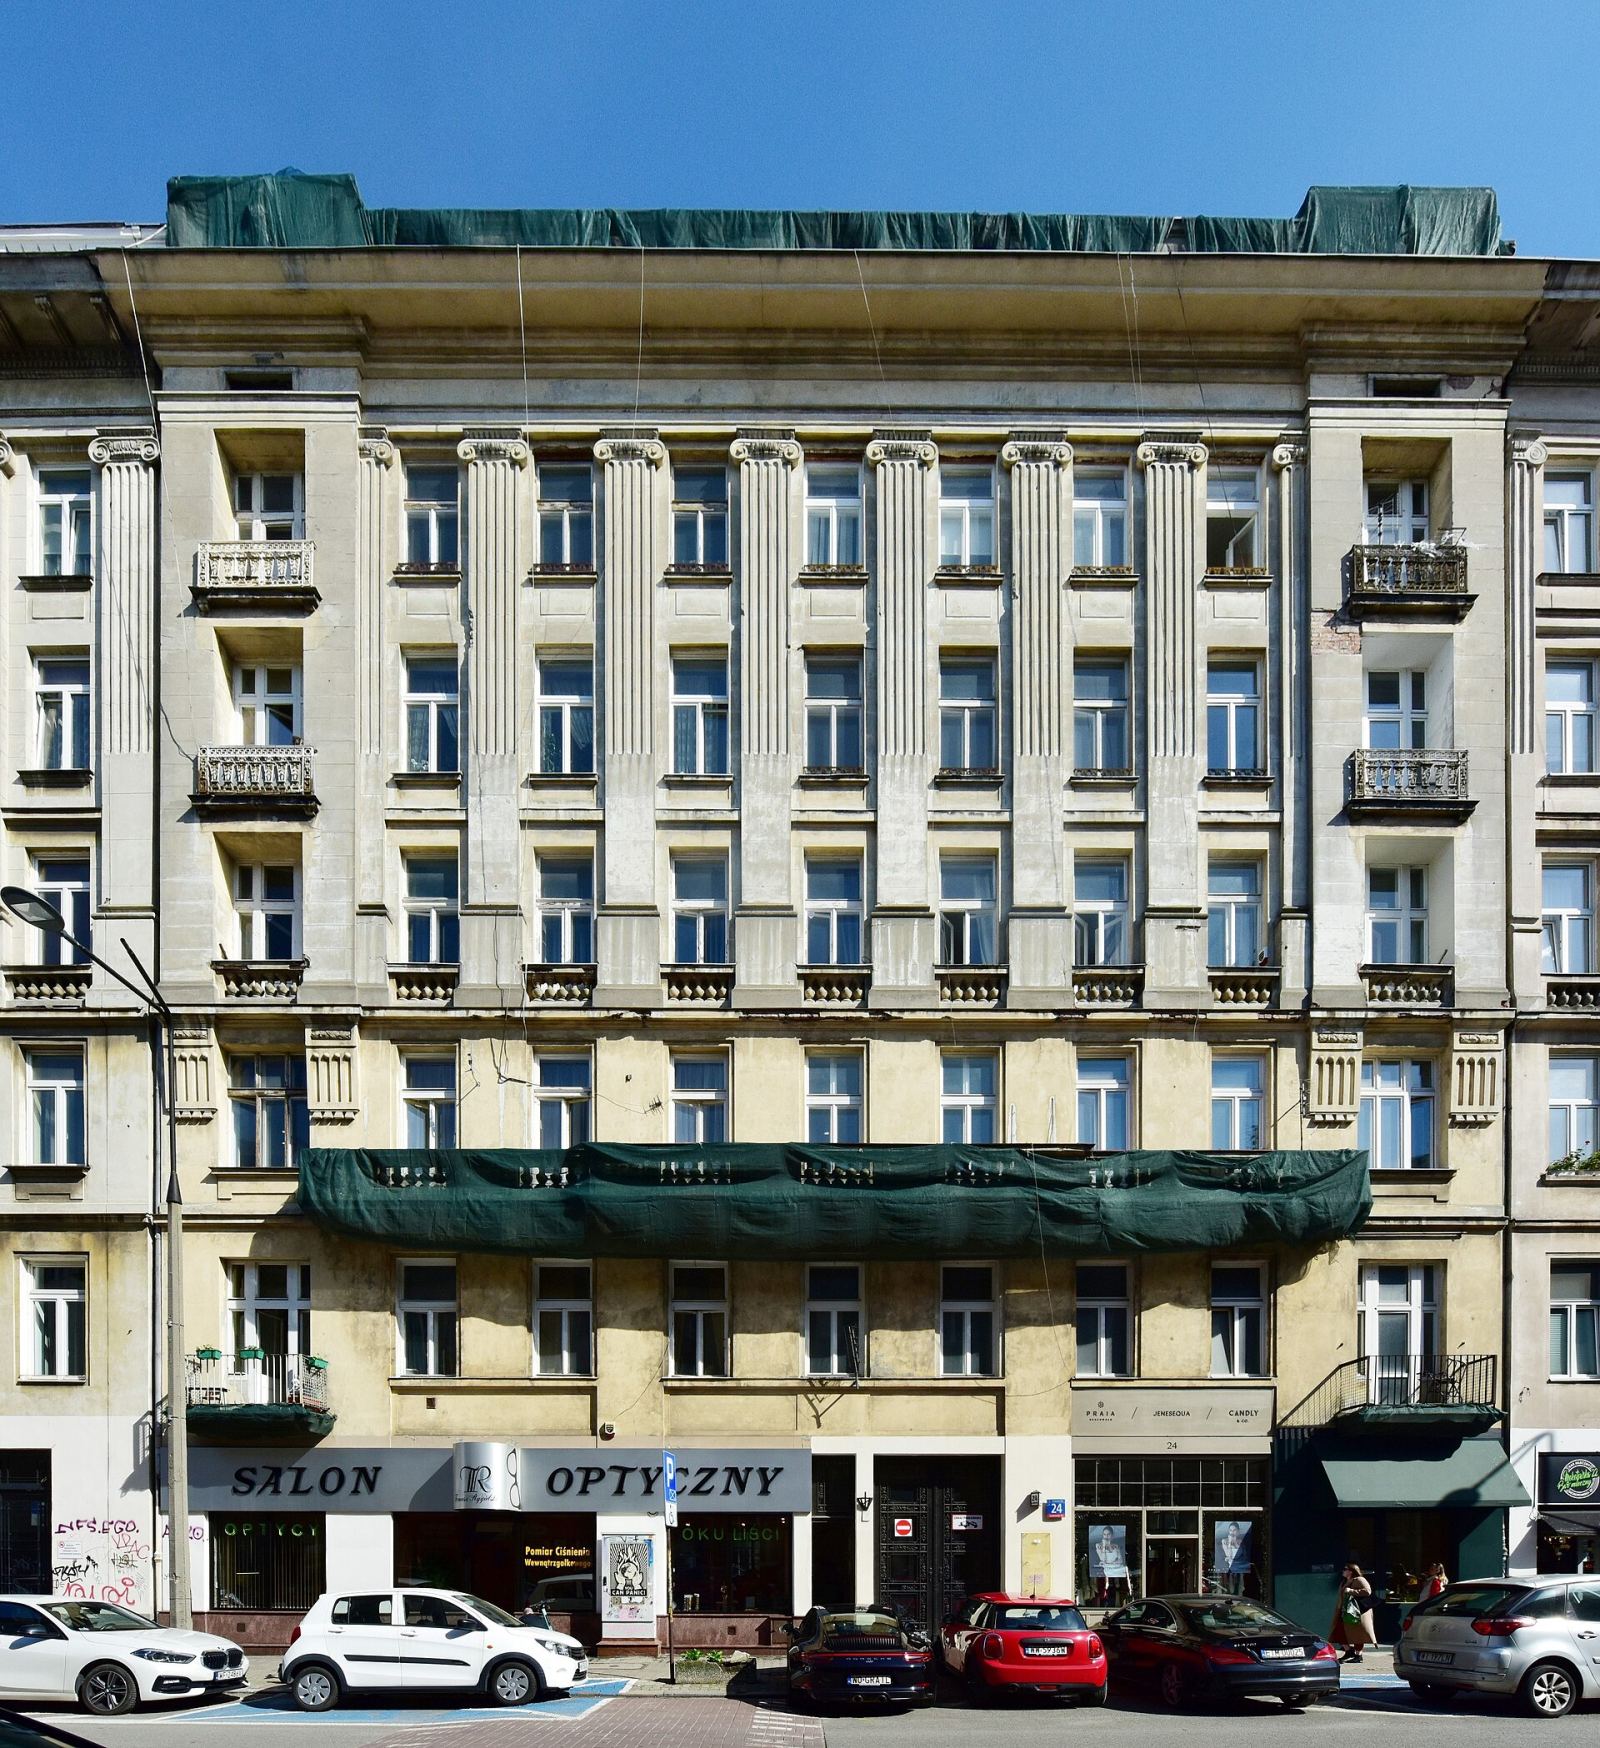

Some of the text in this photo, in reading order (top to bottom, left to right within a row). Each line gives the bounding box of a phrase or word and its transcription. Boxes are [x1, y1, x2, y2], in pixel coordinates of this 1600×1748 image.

[1228, 1409, 1259, 1417] CANDLY
[1166, 1441, 1178, 1450] 24
[232, 1465, 383, 1496] SALON
[546, 1466, 784, 1496] OPTYCZNY
[1051, 1503, 1063, 1514] 24
[525, 1545, 591, 1557] Pomiar Ciśnienia
